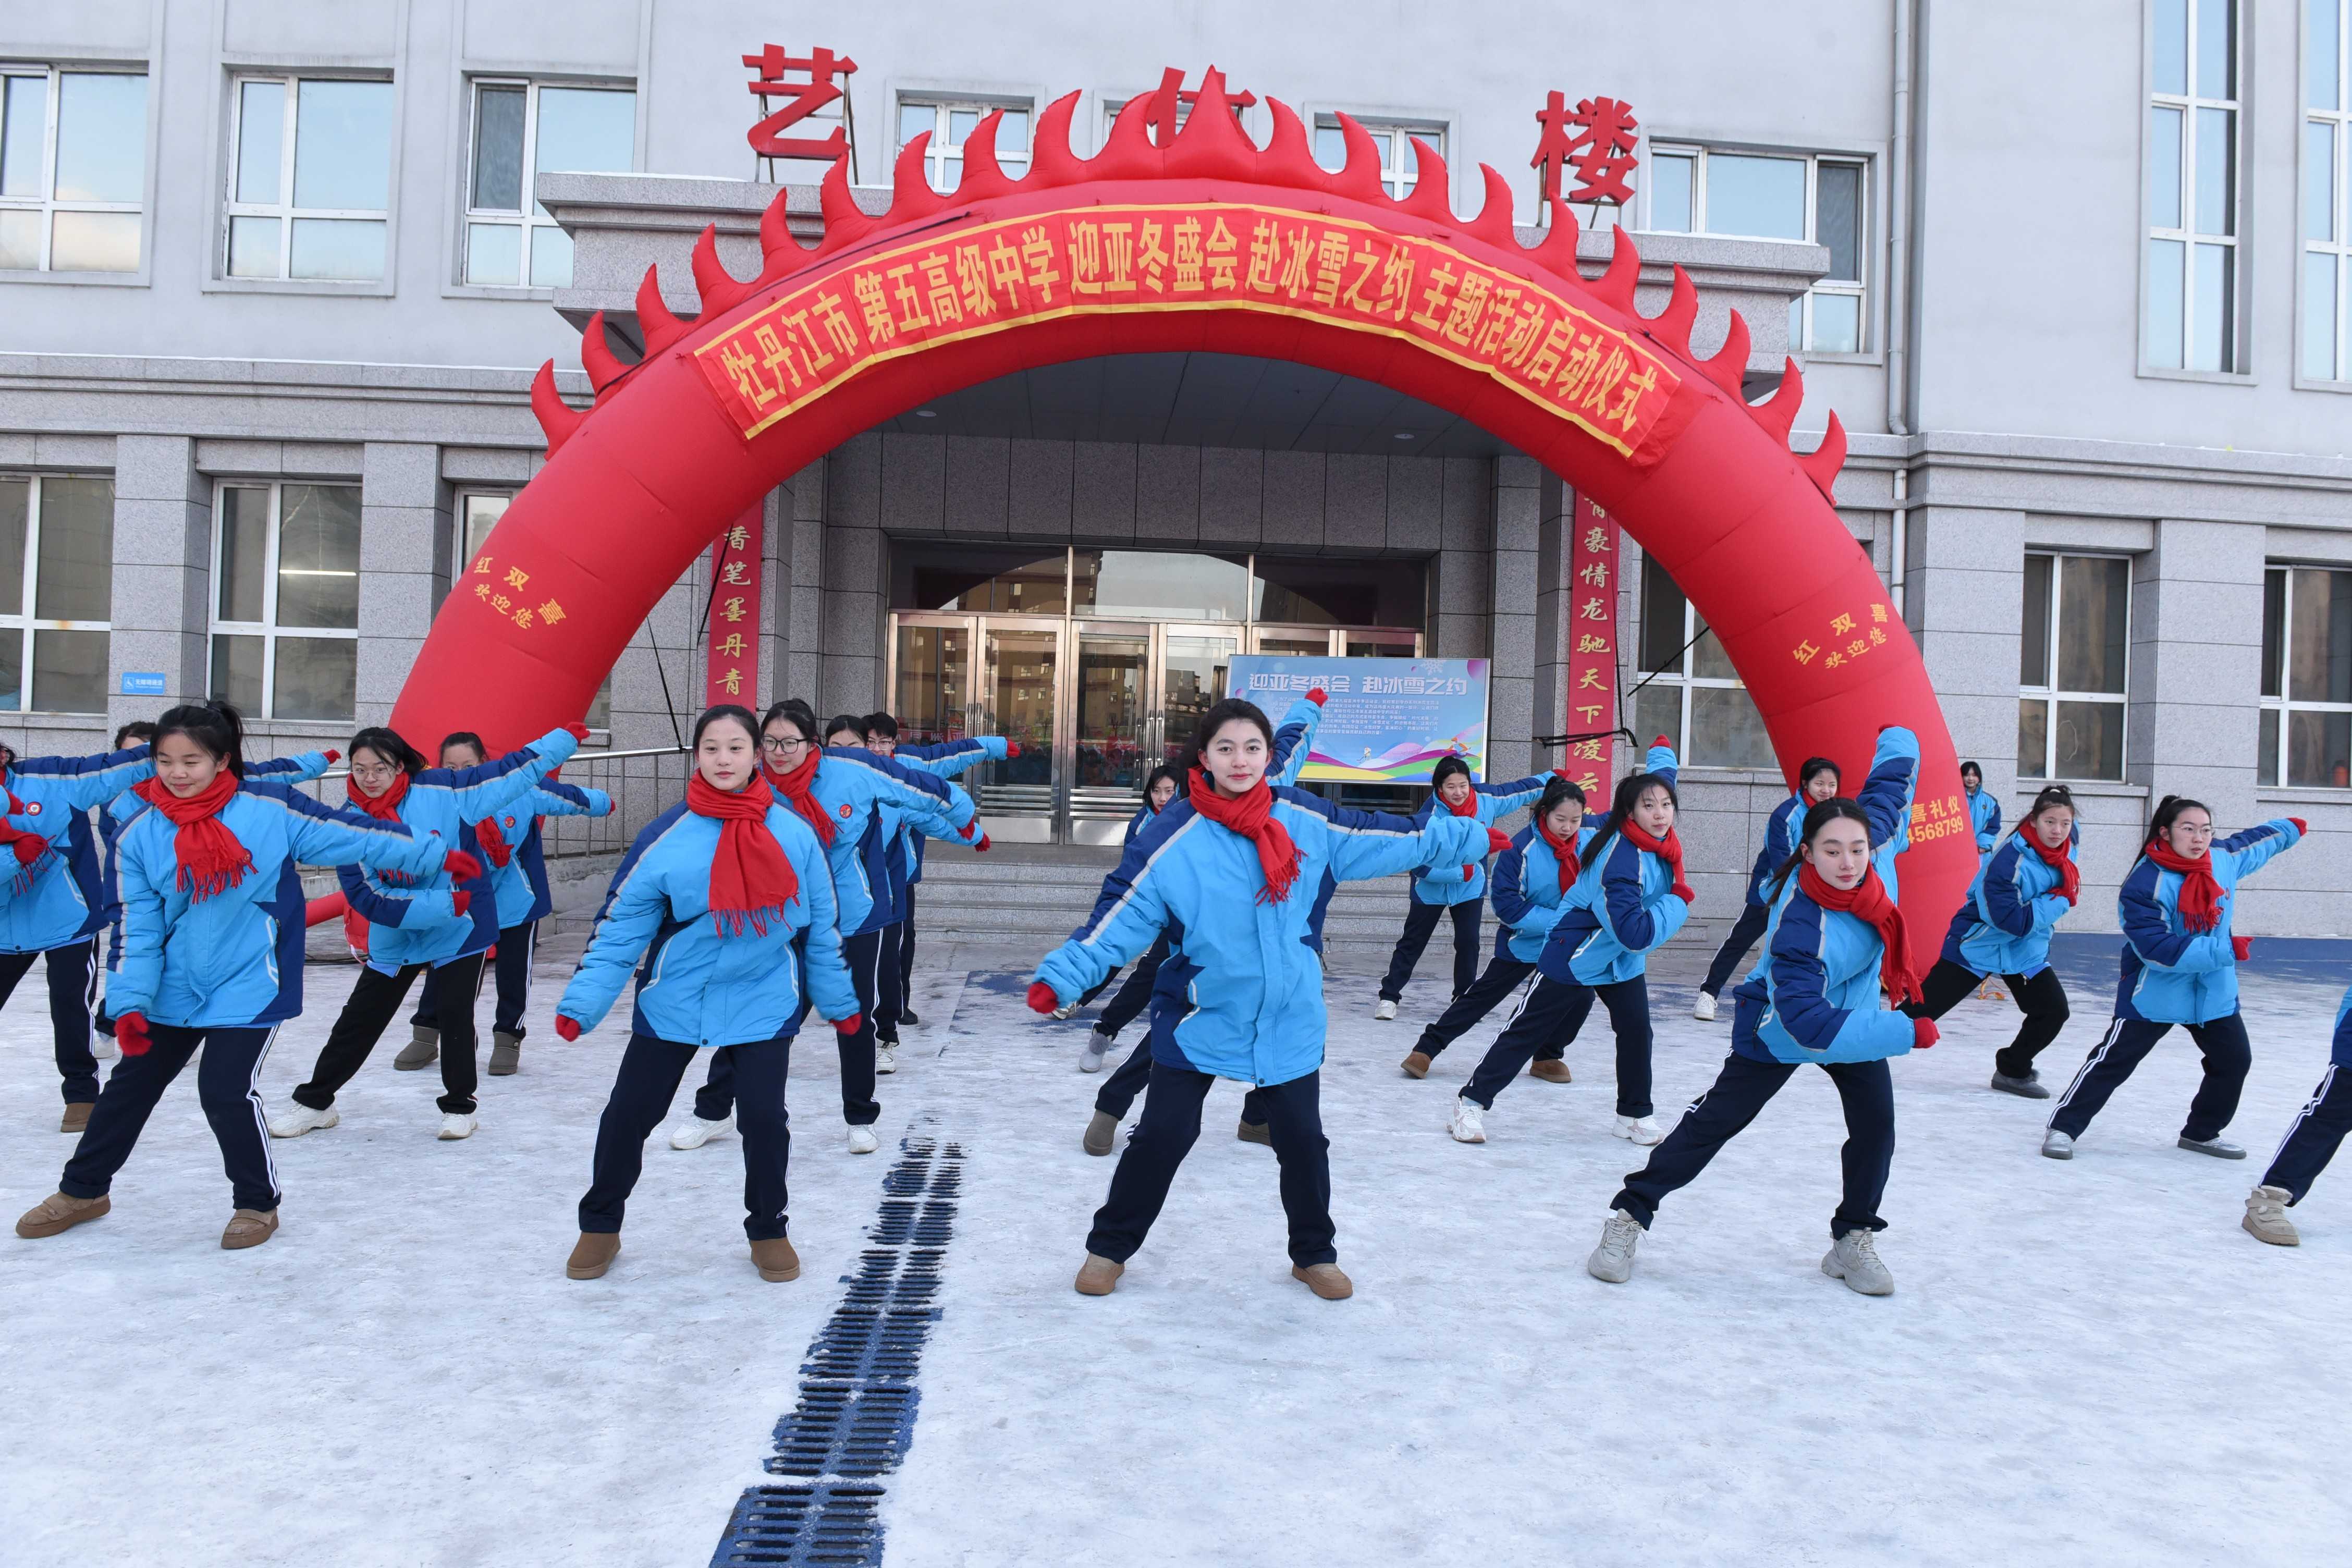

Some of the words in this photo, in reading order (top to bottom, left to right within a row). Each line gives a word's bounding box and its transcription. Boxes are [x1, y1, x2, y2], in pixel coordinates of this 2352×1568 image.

[720, 290, 859, 411] 牡丹江市
[854, 224, 1060, 345] 第五高级中学
[1069, 216, 1238, 295] 迎亚冬盛会
[1244, 218, 1415, 321] 赴冰雪之约
[1411, 262, 1655, 432] 主题活动启动仪式
[474, 557, 567, 626] 红双喜
[1573, 497, 1612, 815] 豪情龙驰天下凌云
[1793, 603, 1888, 665] 红双喜
[1249, 673, 1351, 693] 迎亚冬盛会
[1362, 676, 1468, 696] 赴冰雪之约
